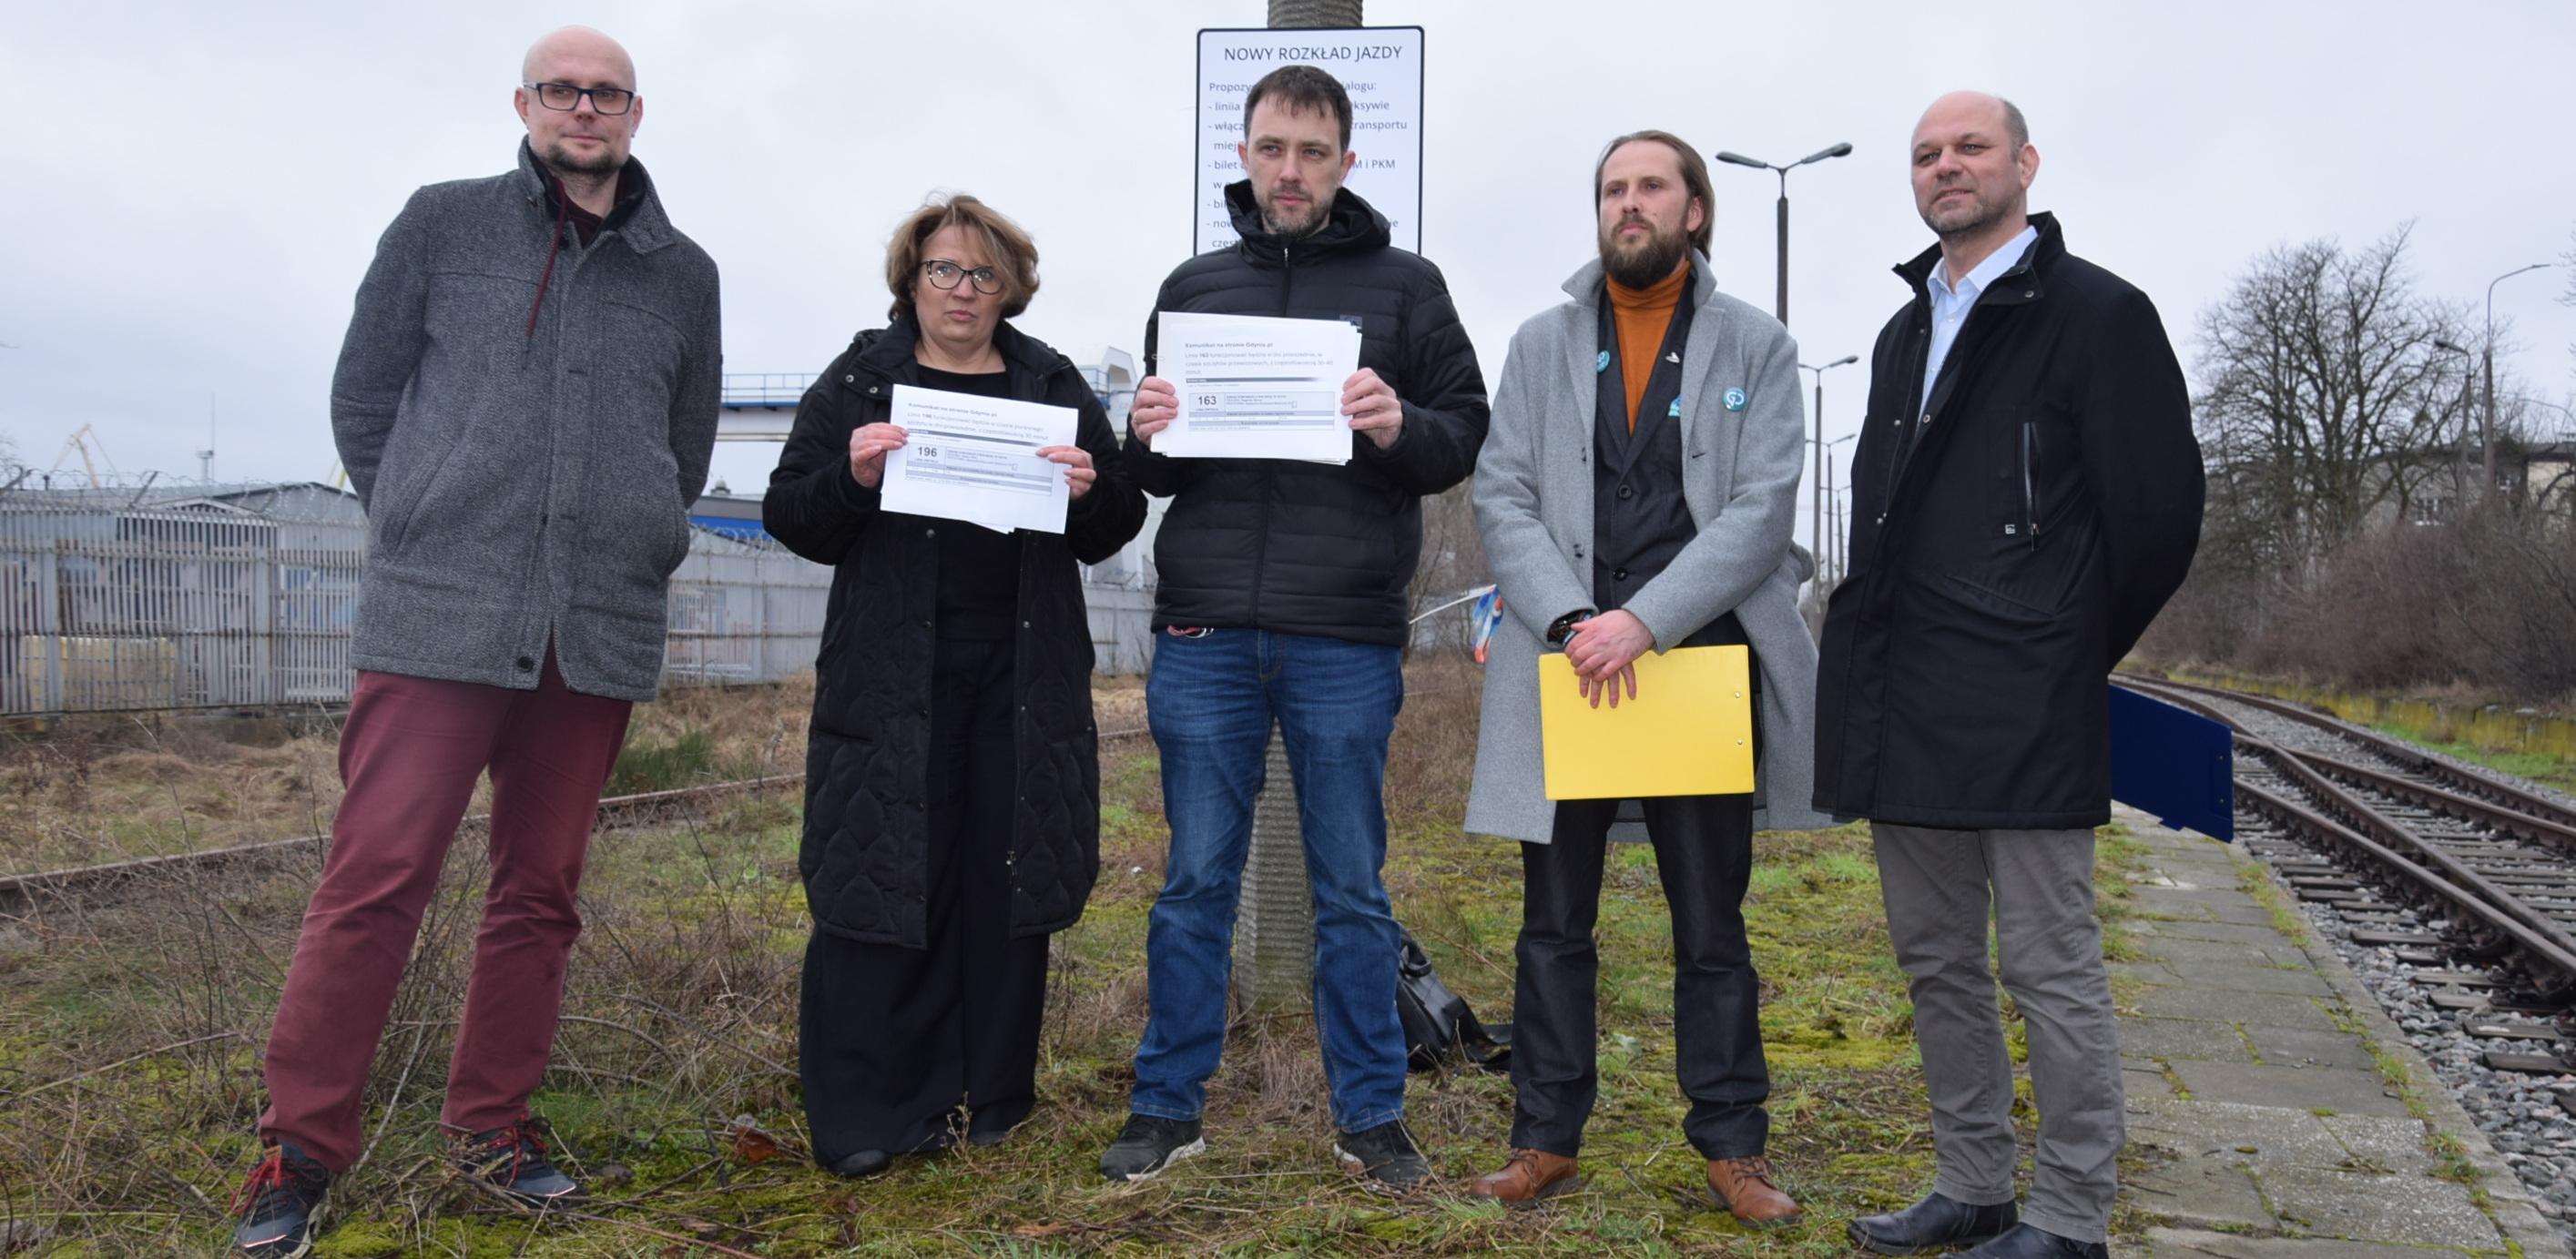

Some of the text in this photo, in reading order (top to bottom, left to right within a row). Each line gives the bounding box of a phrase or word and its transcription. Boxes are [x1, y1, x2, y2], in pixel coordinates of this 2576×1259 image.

[1224, 46, 1402, 62] NOWY ROZKŁAD JAZDY
[1209, 81, 1377, 94] Propozy alogu:
[1353, 100, 1390, 112] ksywie
[1215, 121, 1245, 132] włącz
[1353, 120, 1408, 132] ransportu
[1214, 141, 1237, 152] miej
[1214, 160, 1237, 169] bilet
[1353, 159, 1362, 168] M
[1371, 159, 1396, 168] PKM
[1197, 395, 1217, 406] 163
[918, 446, 938, 458] 196
